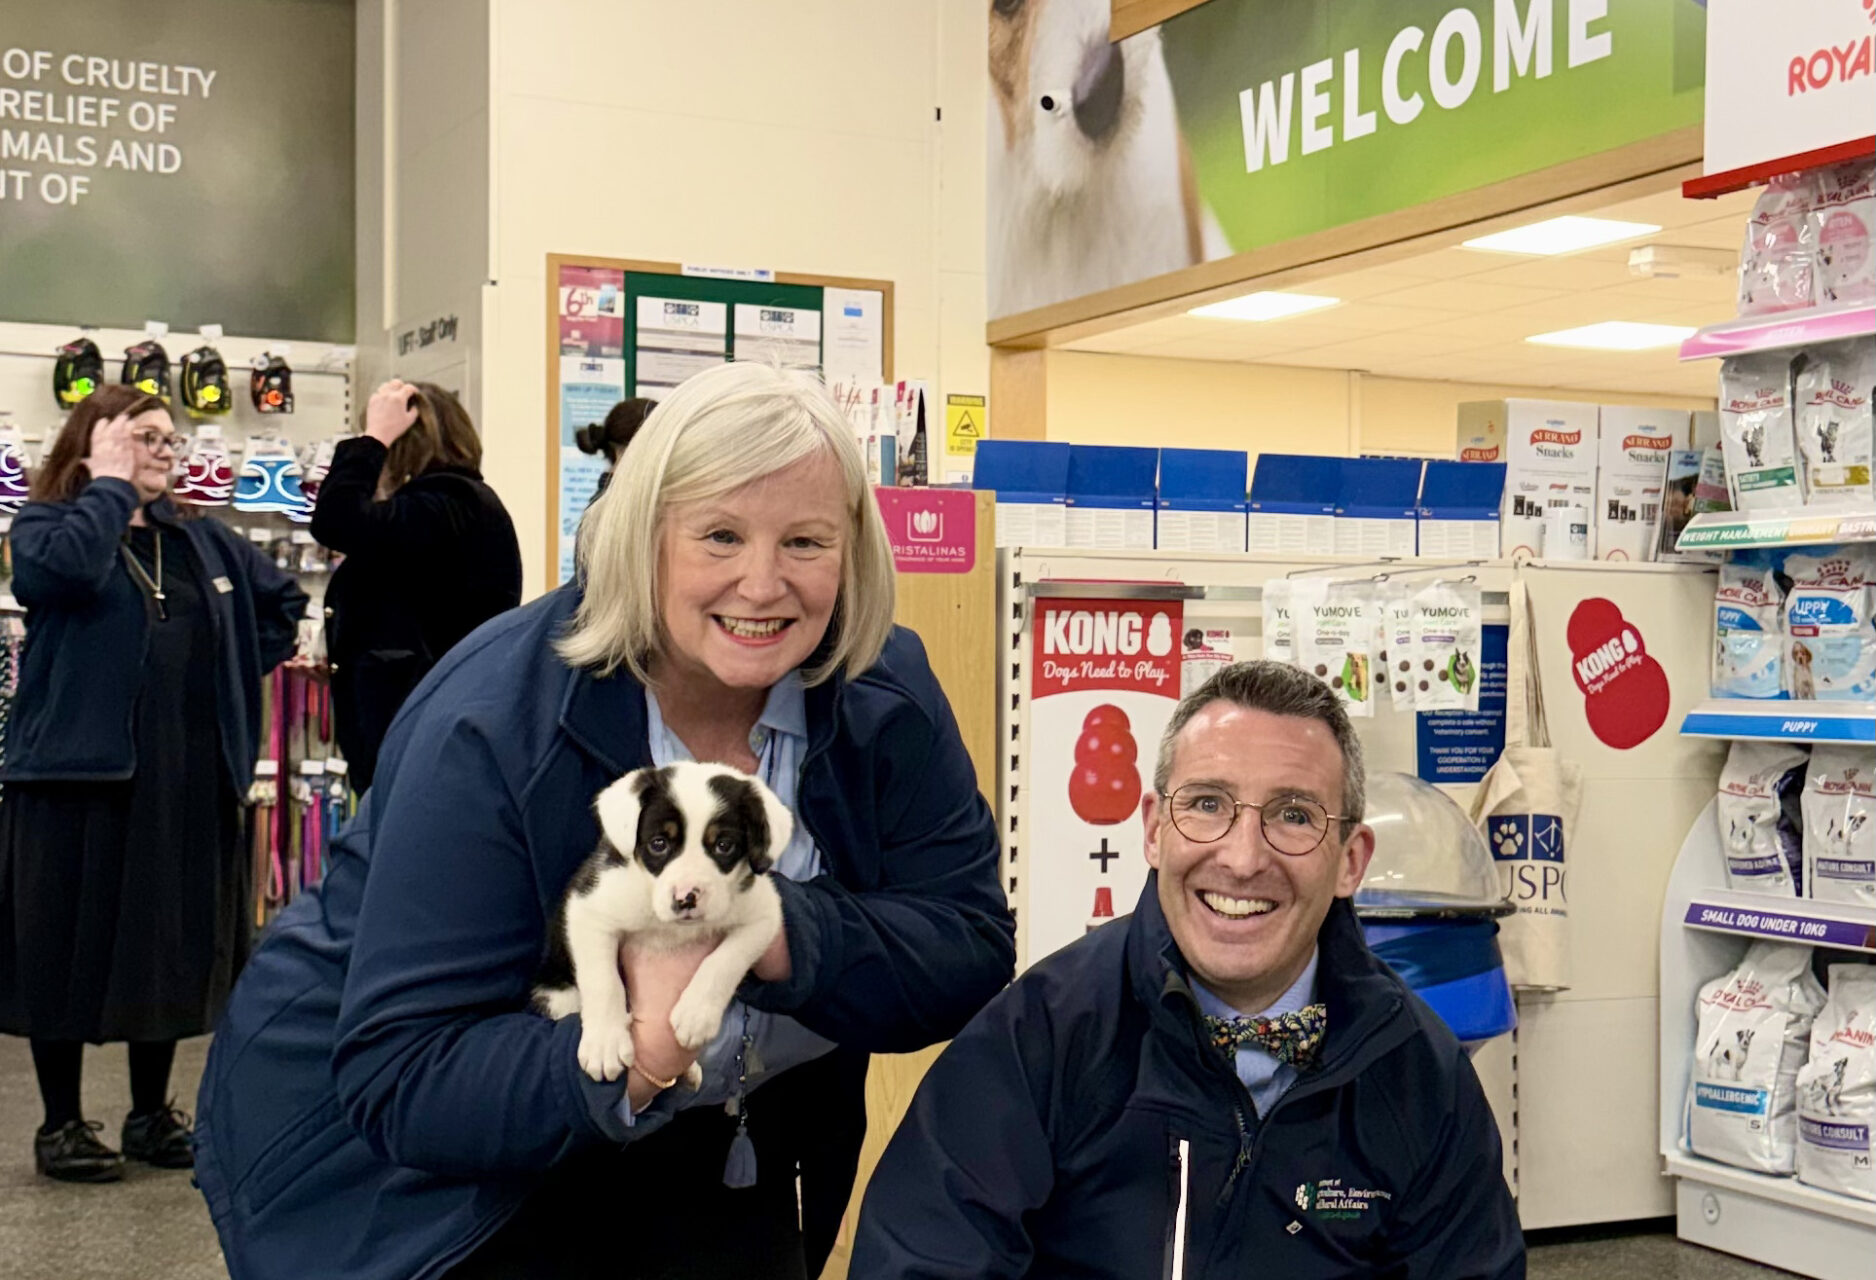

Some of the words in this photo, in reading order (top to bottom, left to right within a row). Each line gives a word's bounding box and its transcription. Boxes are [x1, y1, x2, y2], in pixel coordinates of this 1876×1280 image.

[3, 48, 53, 81] OF
[62, 54, 217, 99] CRUELTY
[1788, 35, 1876, 97] ROYA
[1239, 0, 1612, 174] WELCOME
[0, 88, 120, 128] RELIEF
[128, 101, 177, 133] OF
[105, 140, 182, 174] AND
[0, 169, 32, 201] T
[40, 173, 90, 205] OF
[1533, 431, 1579, 444] SERRANO
[1624, 436, 1670, 449] SERRANO
[1536, 445, 1574, 459] Snacks
[1682, 529, 1718, 543] WEIGHT
[1720, 526, 1788, 541] MANAGEMENT
[1043, 610, 1143, 655] KONG
[1575, 637, 1625, 685] KONG
[1043, 660, 1079, 686] Dogs
[1080, 661, 1116, 679] Need
[1118, 664, 1132, 679] to
[1782, 720, 1818, 734] PUPPY
[1534, 907, 1548, 915] ALL
[1701, 908, 1735, 926] SMALL
[1736, 914, 1759, 929] DOG
[1759, 916, 1799, 934] UNDER
[1799, 921, 1828, 937] 10KG
[1750, 1120, 1760, 1130] S
[1823, 1127, 1864, 1141] CONSULT
[1854, 1155, 1869, 1167] M
[1338, 1199, 1369, 1210] Affairs
